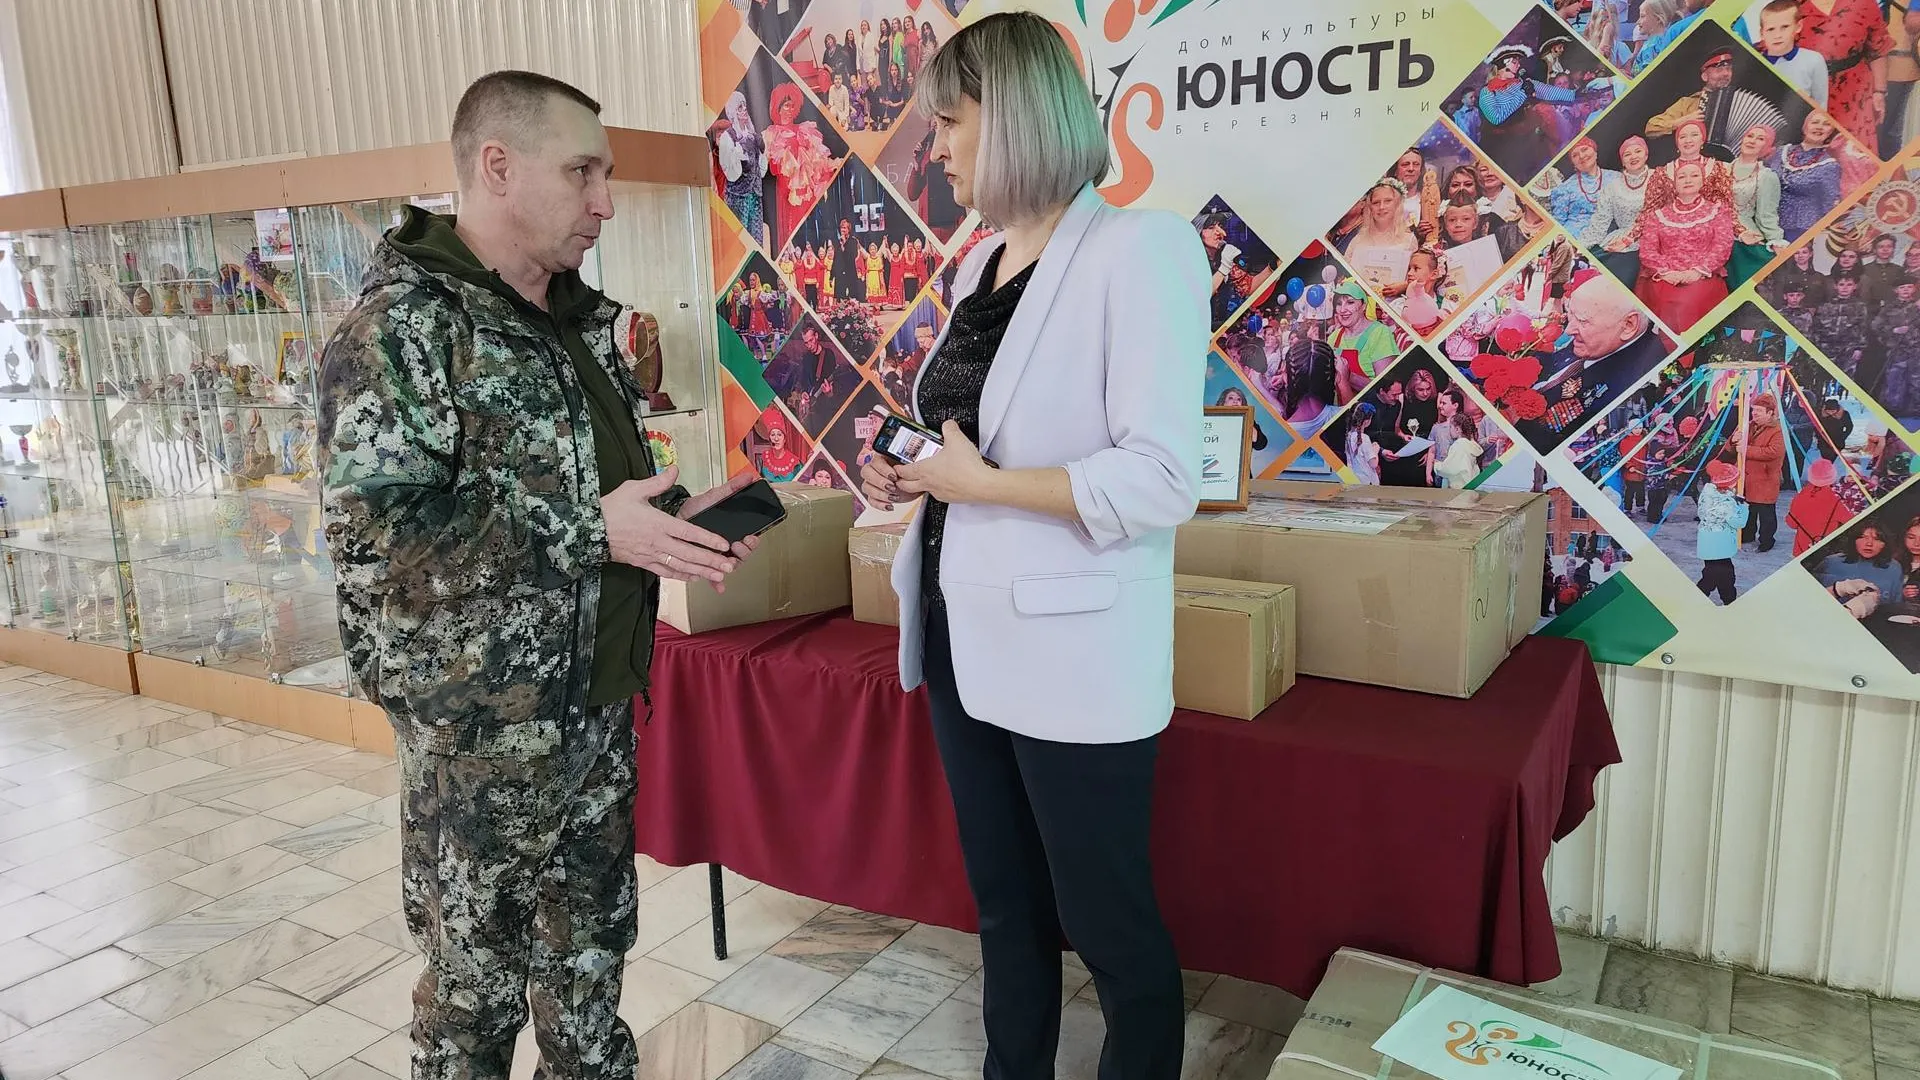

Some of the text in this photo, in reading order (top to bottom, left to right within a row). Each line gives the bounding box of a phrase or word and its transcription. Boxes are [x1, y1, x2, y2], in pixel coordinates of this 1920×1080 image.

[1176, 37, 1435, 111] ЮНОСТЬ
[1175, 100, 1430, 135] БЕРЕЗНЯКИ
[853, 202, 886, 233] 35
